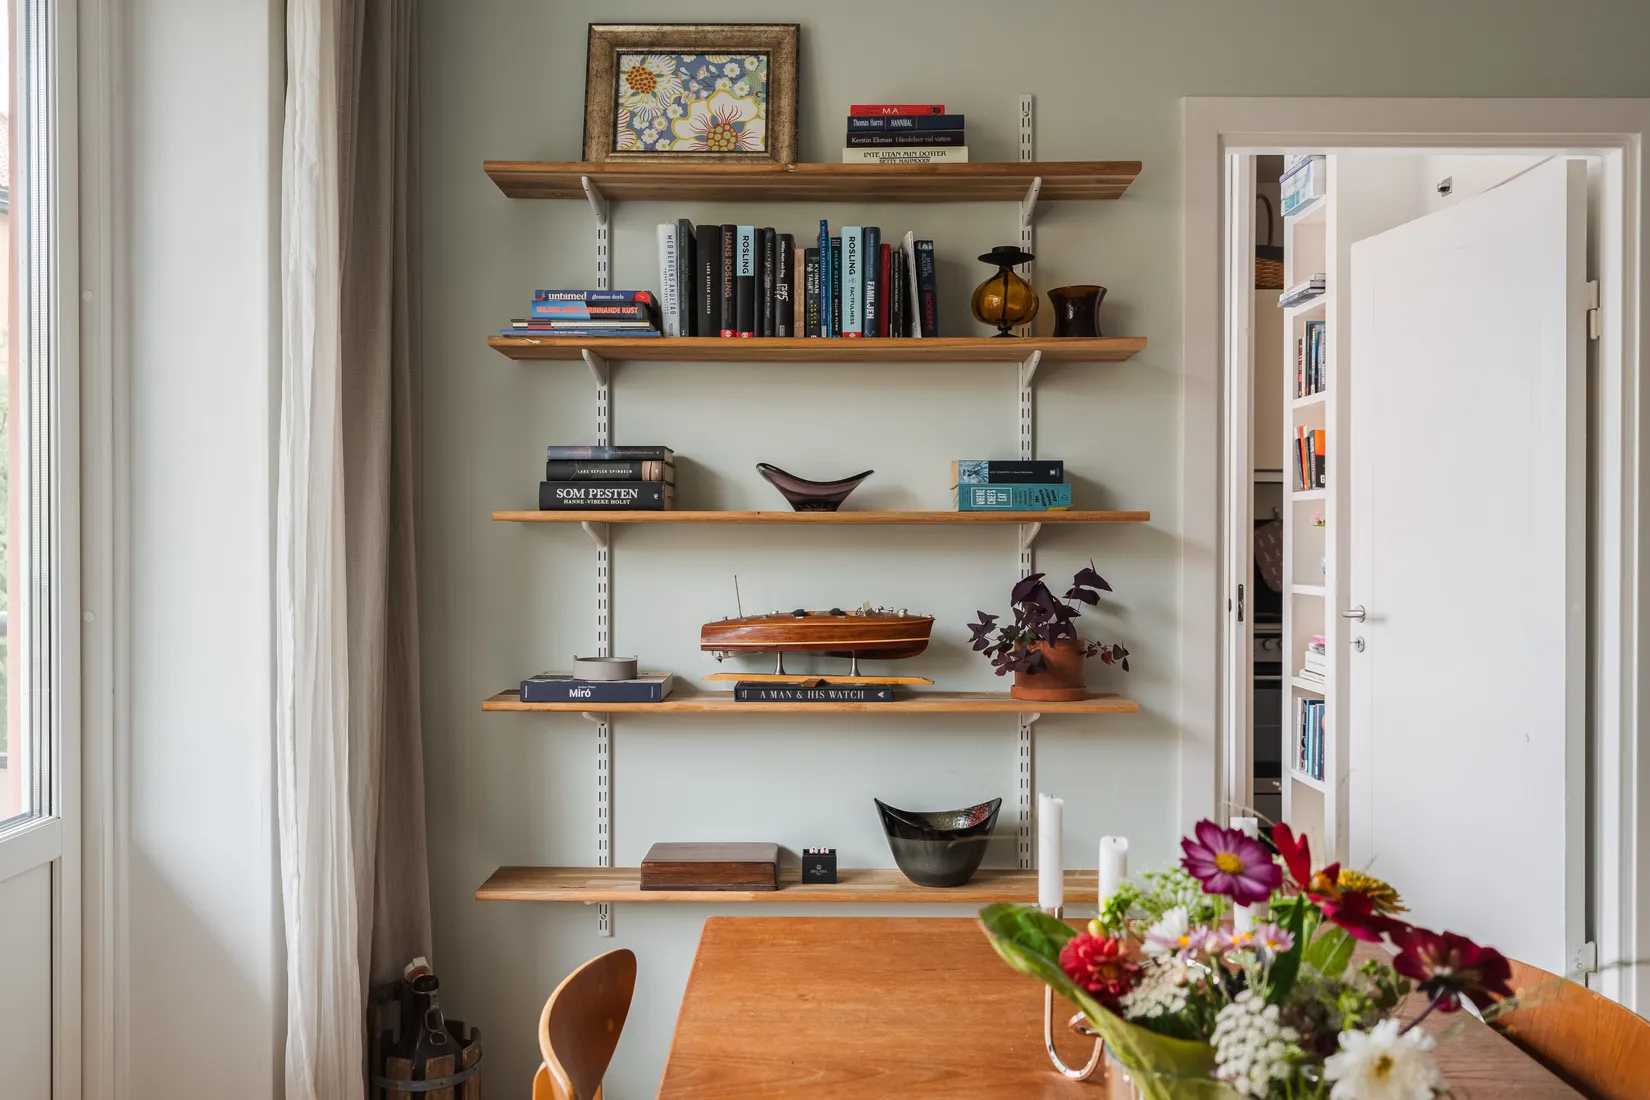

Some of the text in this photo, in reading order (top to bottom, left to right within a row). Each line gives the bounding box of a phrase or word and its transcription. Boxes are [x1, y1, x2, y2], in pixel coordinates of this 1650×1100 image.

[853, 119, 912, 127] Thomas Harris HANNIBAL
[724, 231, 732, 258] HANS
[742, 235, 750, 275] ROSLING
[848, 236, 856, 275] ROSLING
[667, 250, 676, 282] BERGENS
[723, 258, 732, 298] ROSLING
[548, 291, 625, 301] untamed glennon doyle
[668, 284, 677, 316] ANDETAG
[866, 281, 875, 319] FAMILJEN
[583, 306, 621, 314] BRINNANDE
[621, 306, 639, 314] KUST
[556, 488, 638, 499] SOM PESTEN
[987, 489, 996, 505] CHEFS
[997, 493, 1007, 502] EAT
[569, 688, 591, 698] Miró
[760, 690, 865, 698] A MAN & HIS WATCH
